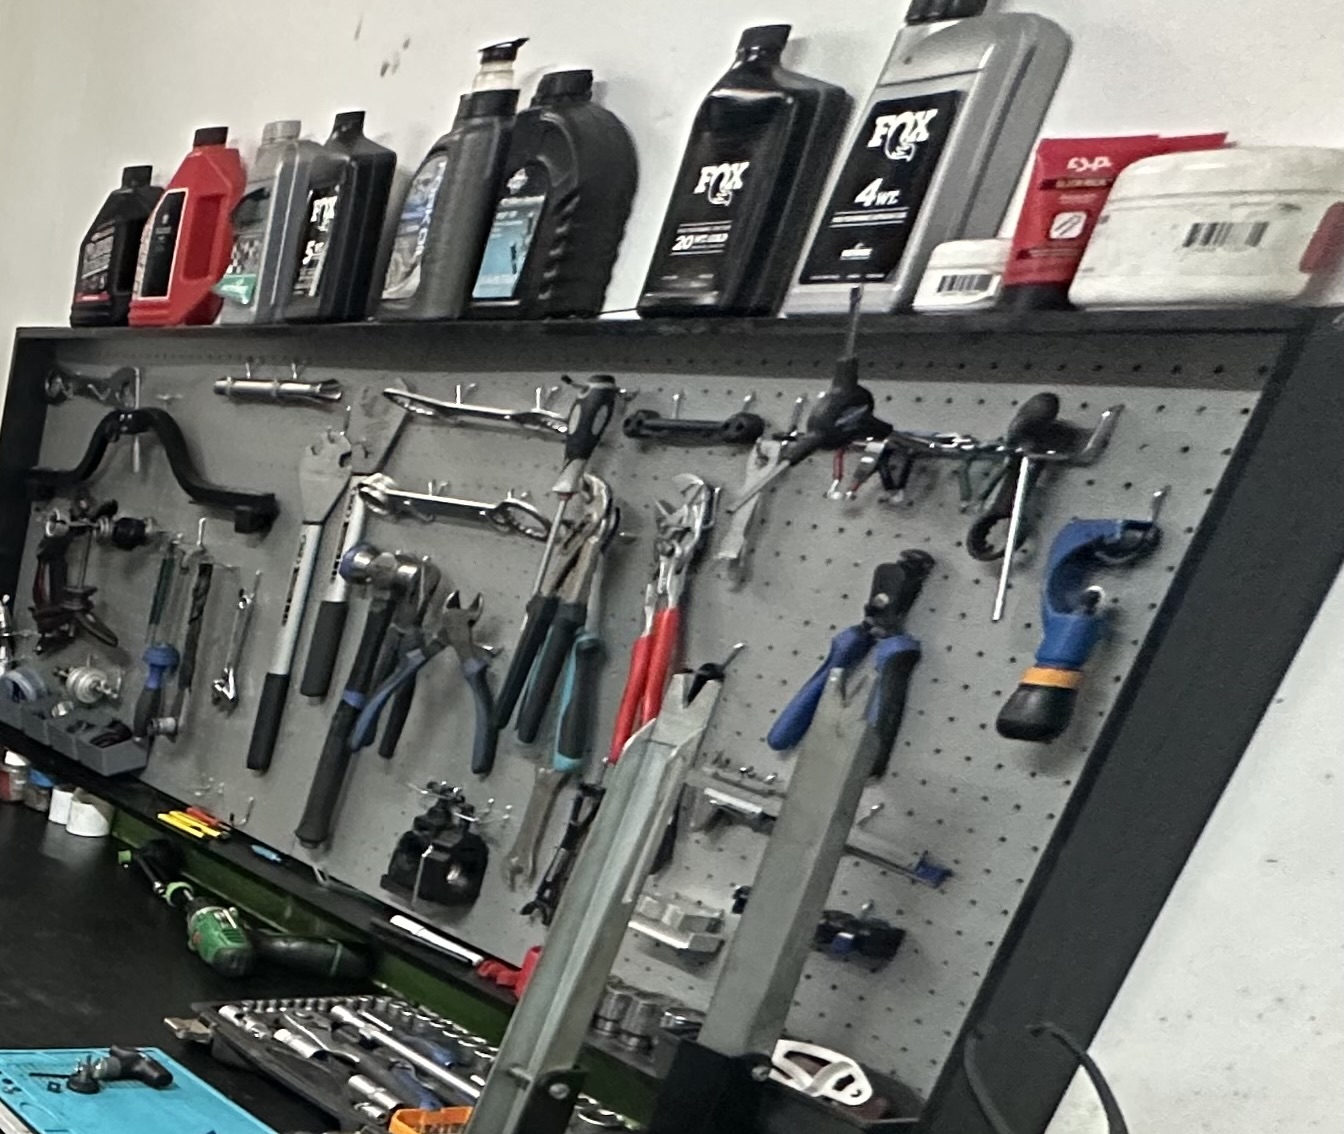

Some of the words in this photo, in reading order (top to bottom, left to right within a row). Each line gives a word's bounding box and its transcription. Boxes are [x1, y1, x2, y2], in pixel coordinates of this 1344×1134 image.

[866, 108, 939, 162] FOX
[693, 161, 750, 207] FOX
[310, 195, 338, 232] FOX
